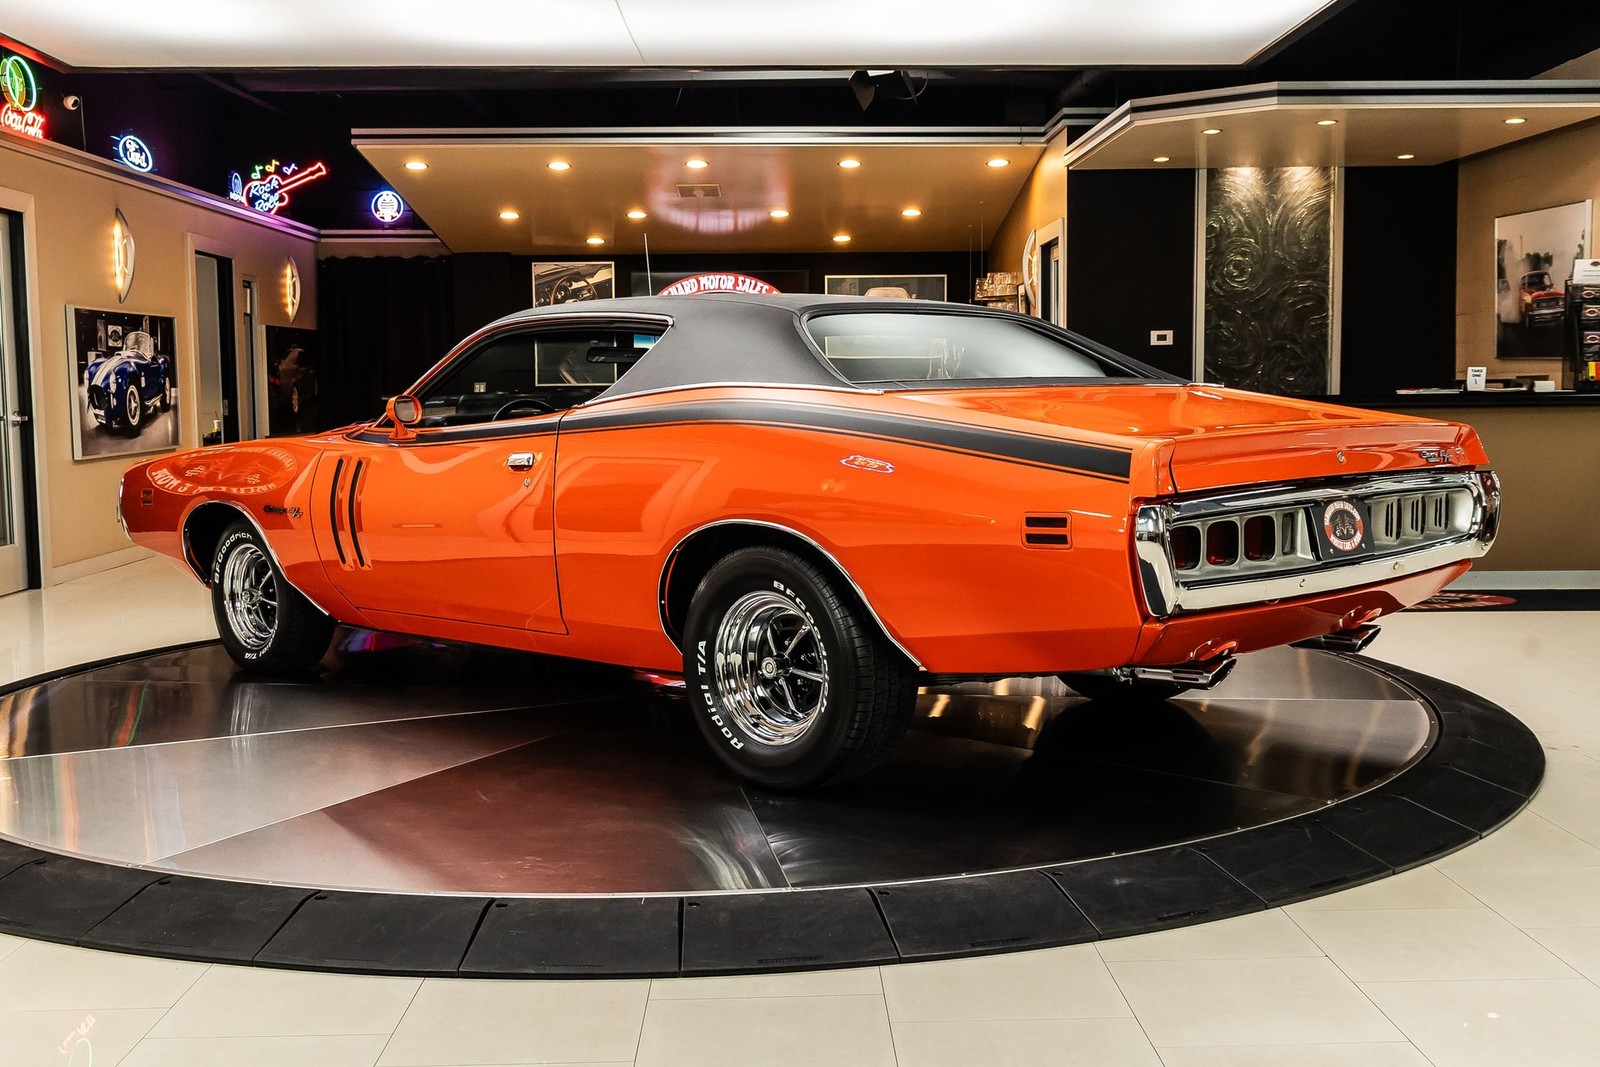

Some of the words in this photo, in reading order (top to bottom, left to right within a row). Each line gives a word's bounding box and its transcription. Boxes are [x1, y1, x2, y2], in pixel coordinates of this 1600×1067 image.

[249, 177, 279, 198] Rock
[254, 192, 280, 212] Roll
[698, 274, 735, 291] MOTOR
[736, 276, 769, 294] SALES
[213, 530, 253, 584] BFGoodrich
[697, 640, 707, 676] T/A
[700, 684, 744, 750] Radial
